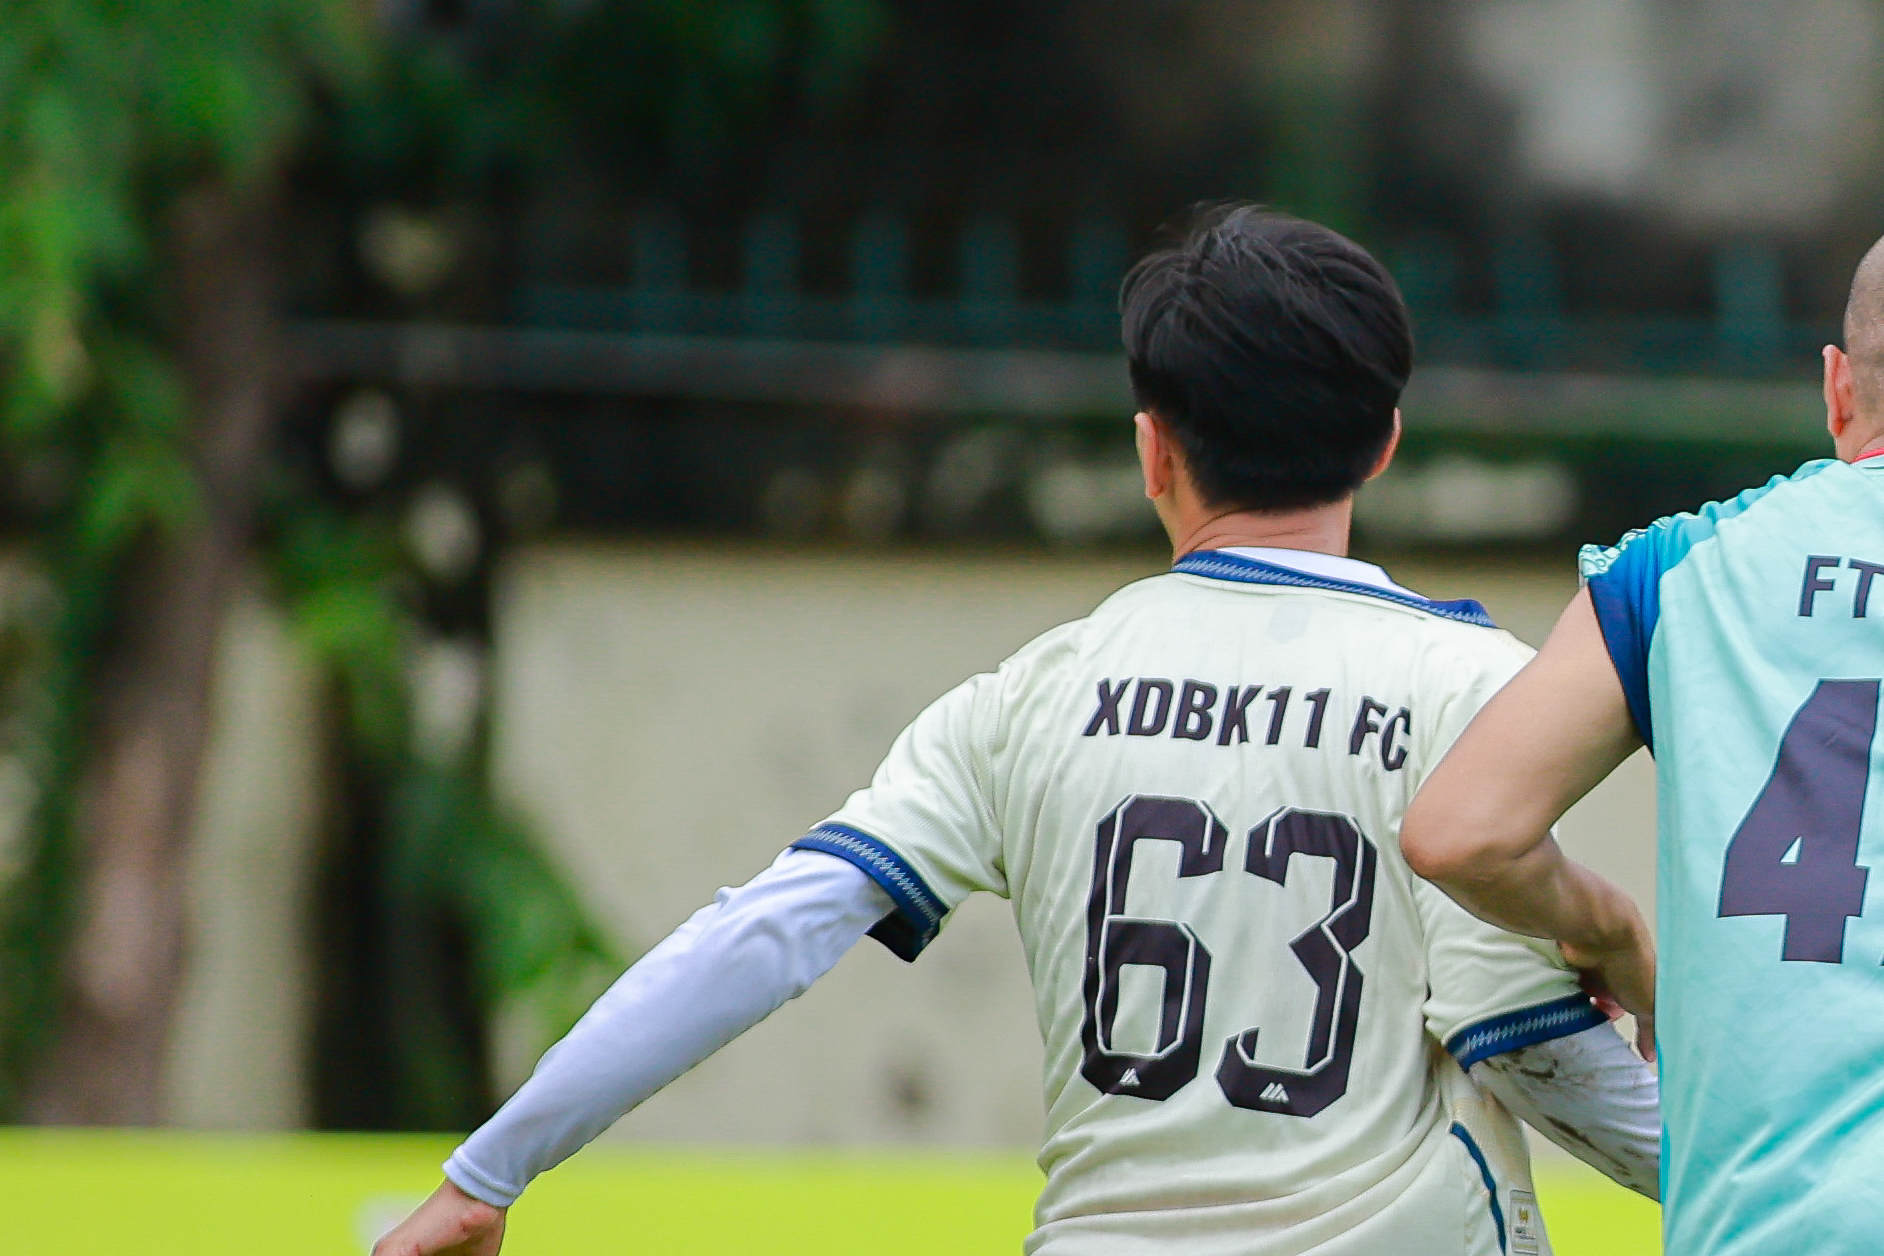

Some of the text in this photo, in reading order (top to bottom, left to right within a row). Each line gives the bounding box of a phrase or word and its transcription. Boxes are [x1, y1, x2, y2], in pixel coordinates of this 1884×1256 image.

[1082, 676, 1411, 771] XDBK11 FC
[1081, 793, 1378, 1118] 63
